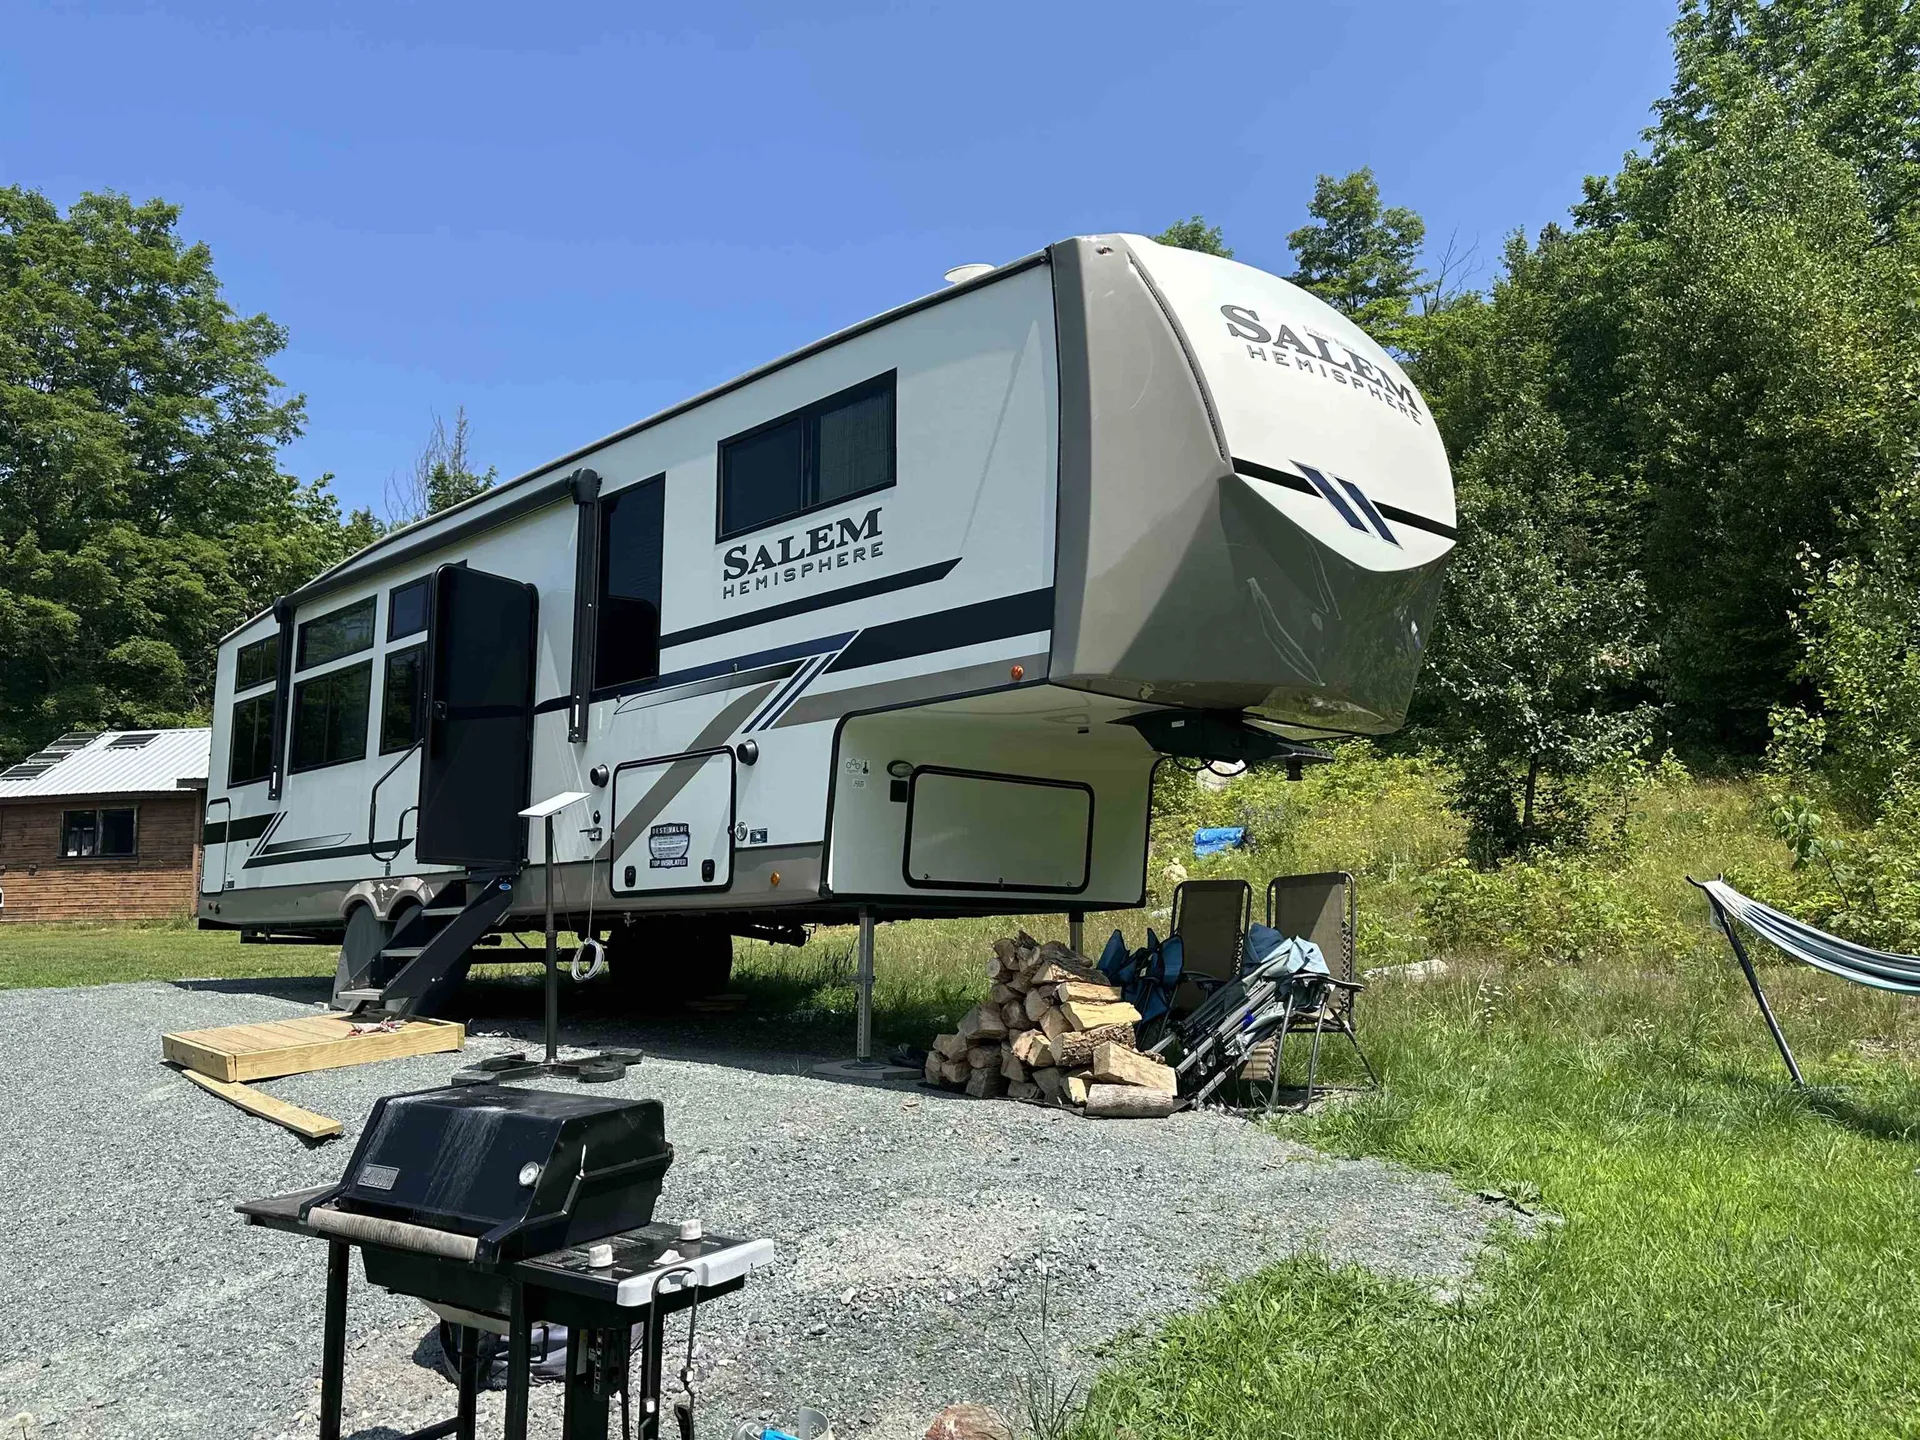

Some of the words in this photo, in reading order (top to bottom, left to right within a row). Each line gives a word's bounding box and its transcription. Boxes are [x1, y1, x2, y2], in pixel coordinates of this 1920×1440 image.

[1220, 304, 1422, 416] SALEM
[1247, 345, 1422, 426] HEMISPHERE
[722, 541, 884, 599] HEMISPHERE
[723, 507, 883, 581] SALEM
